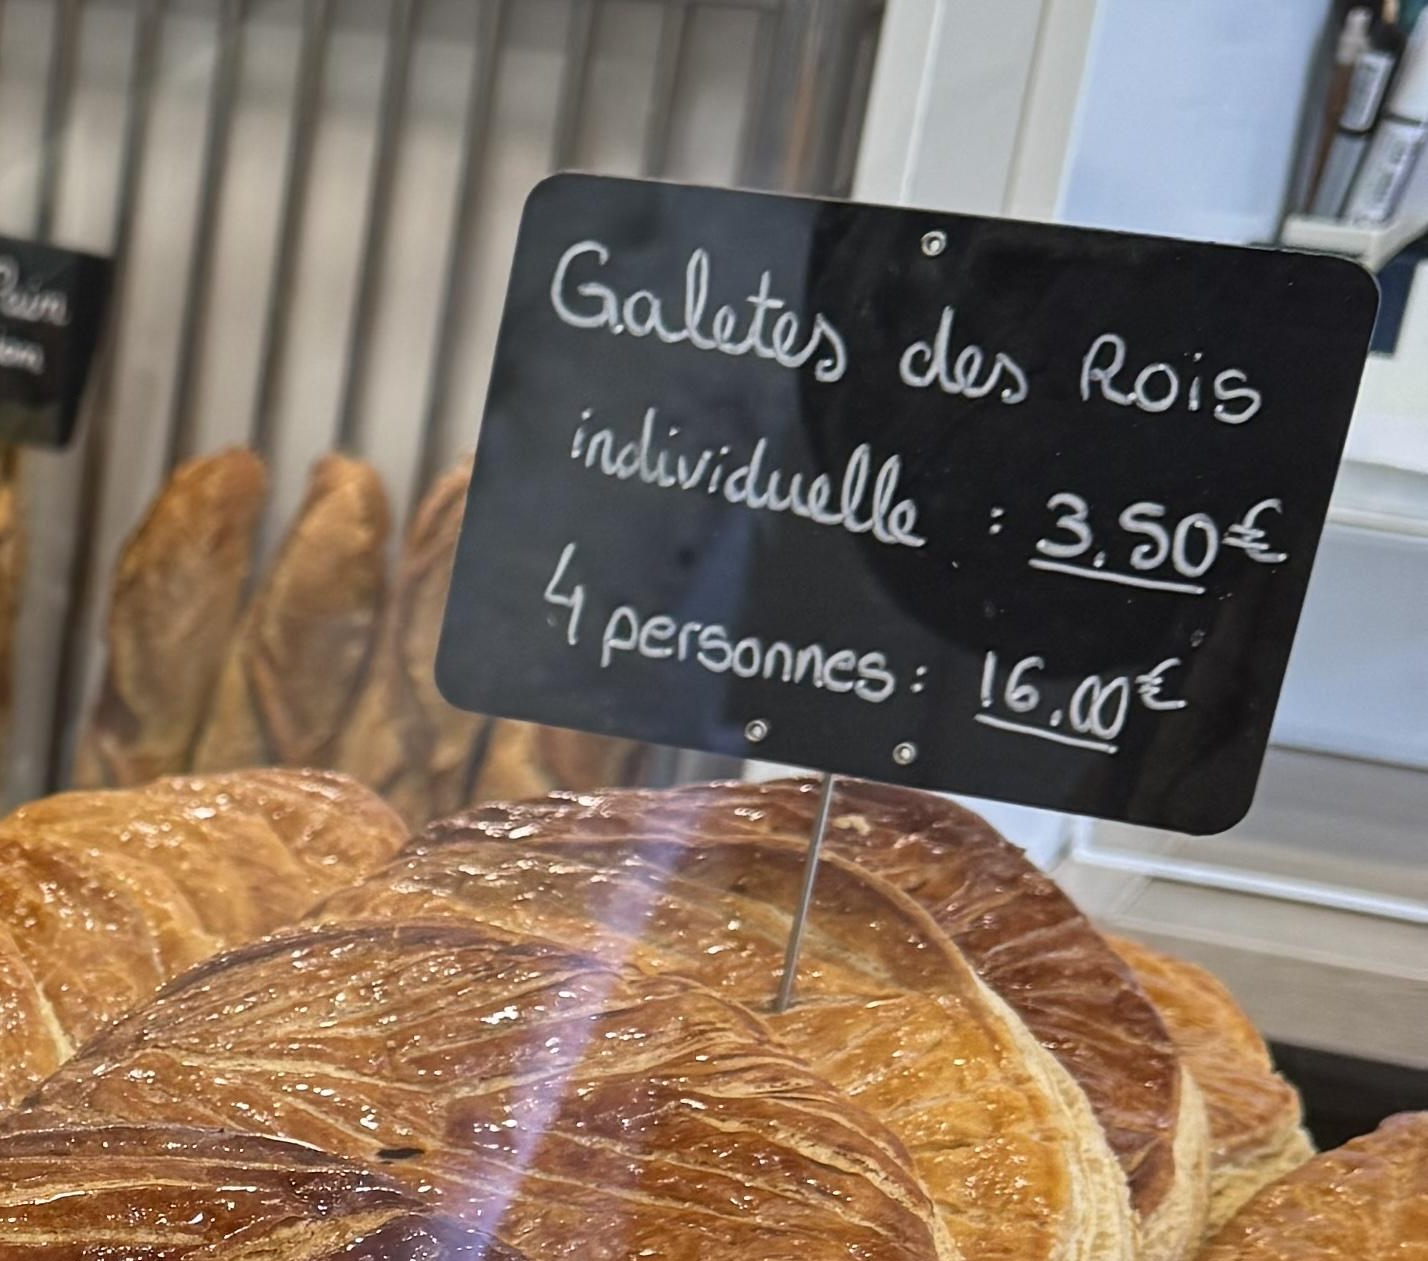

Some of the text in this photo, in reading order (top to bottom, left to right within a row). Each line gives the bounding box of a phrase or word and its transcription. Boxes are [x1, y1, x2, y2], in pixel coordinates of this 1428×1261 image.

[549, 238, 1262, 425] Galetes des Rois
[570, 407, 927, 547] individuelle
[543, 542, 586, 646] 4
